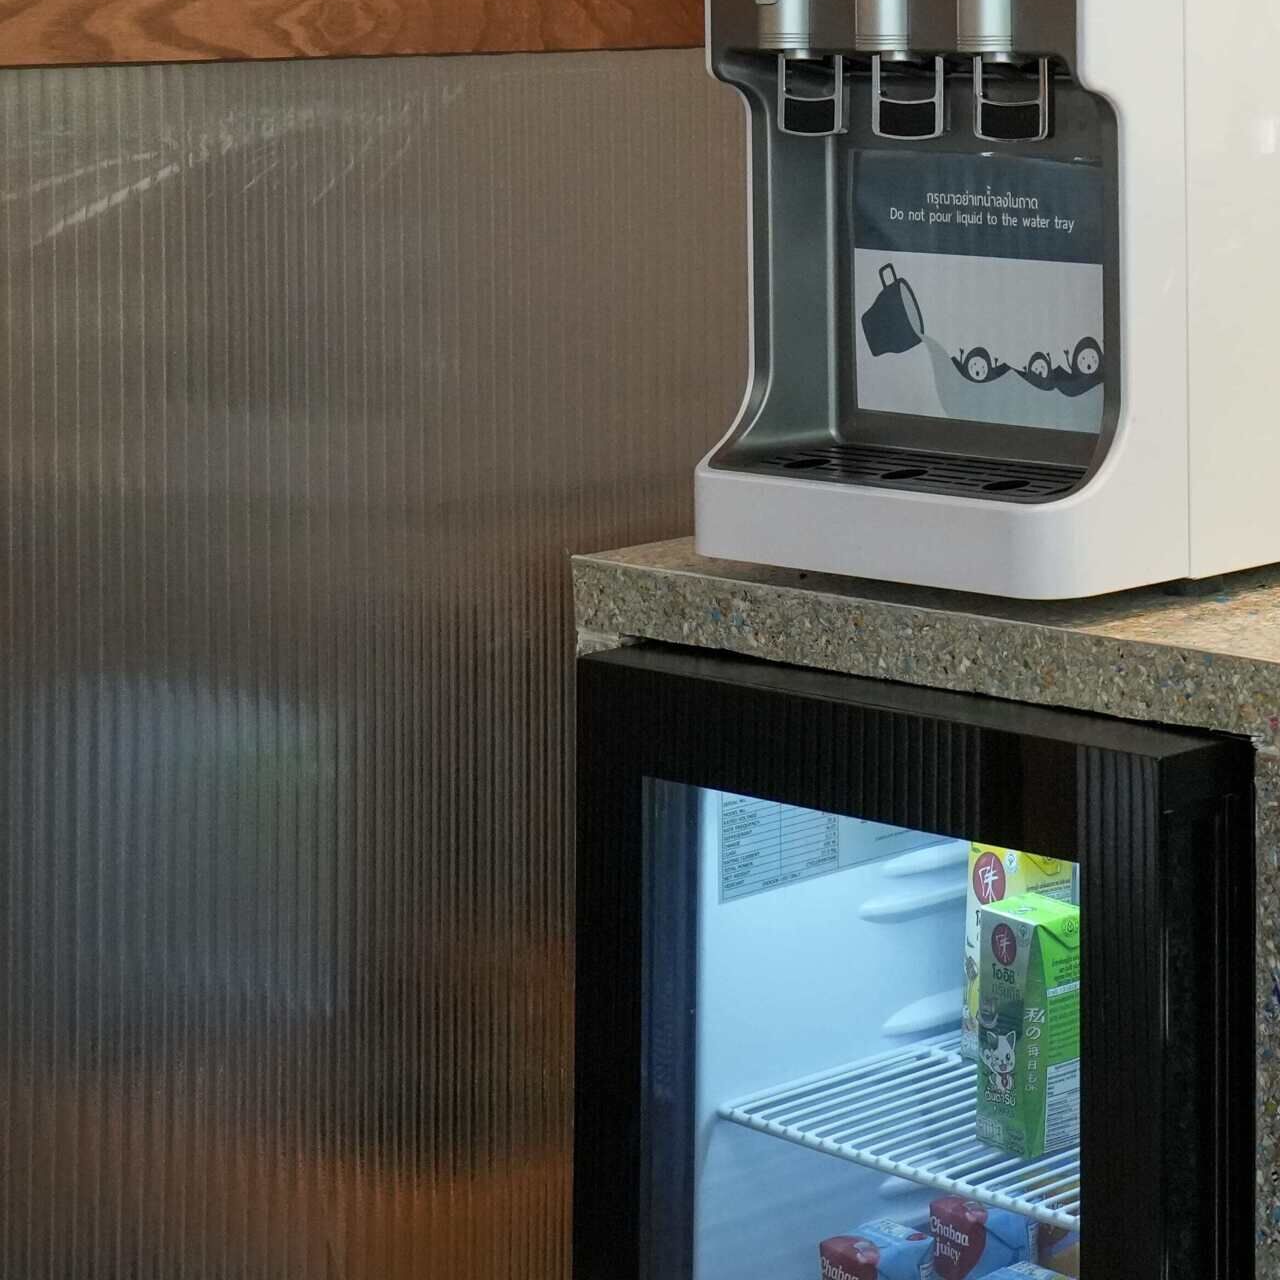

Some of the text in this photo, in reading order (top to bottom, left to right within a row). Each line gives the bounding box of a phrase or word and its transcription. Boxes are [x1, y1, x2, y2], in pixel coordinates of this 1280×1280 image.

[889, 207, 1075, 234] Do not pour liquid to the water tray
[929, 1215, 970, 1247] Chabaa
